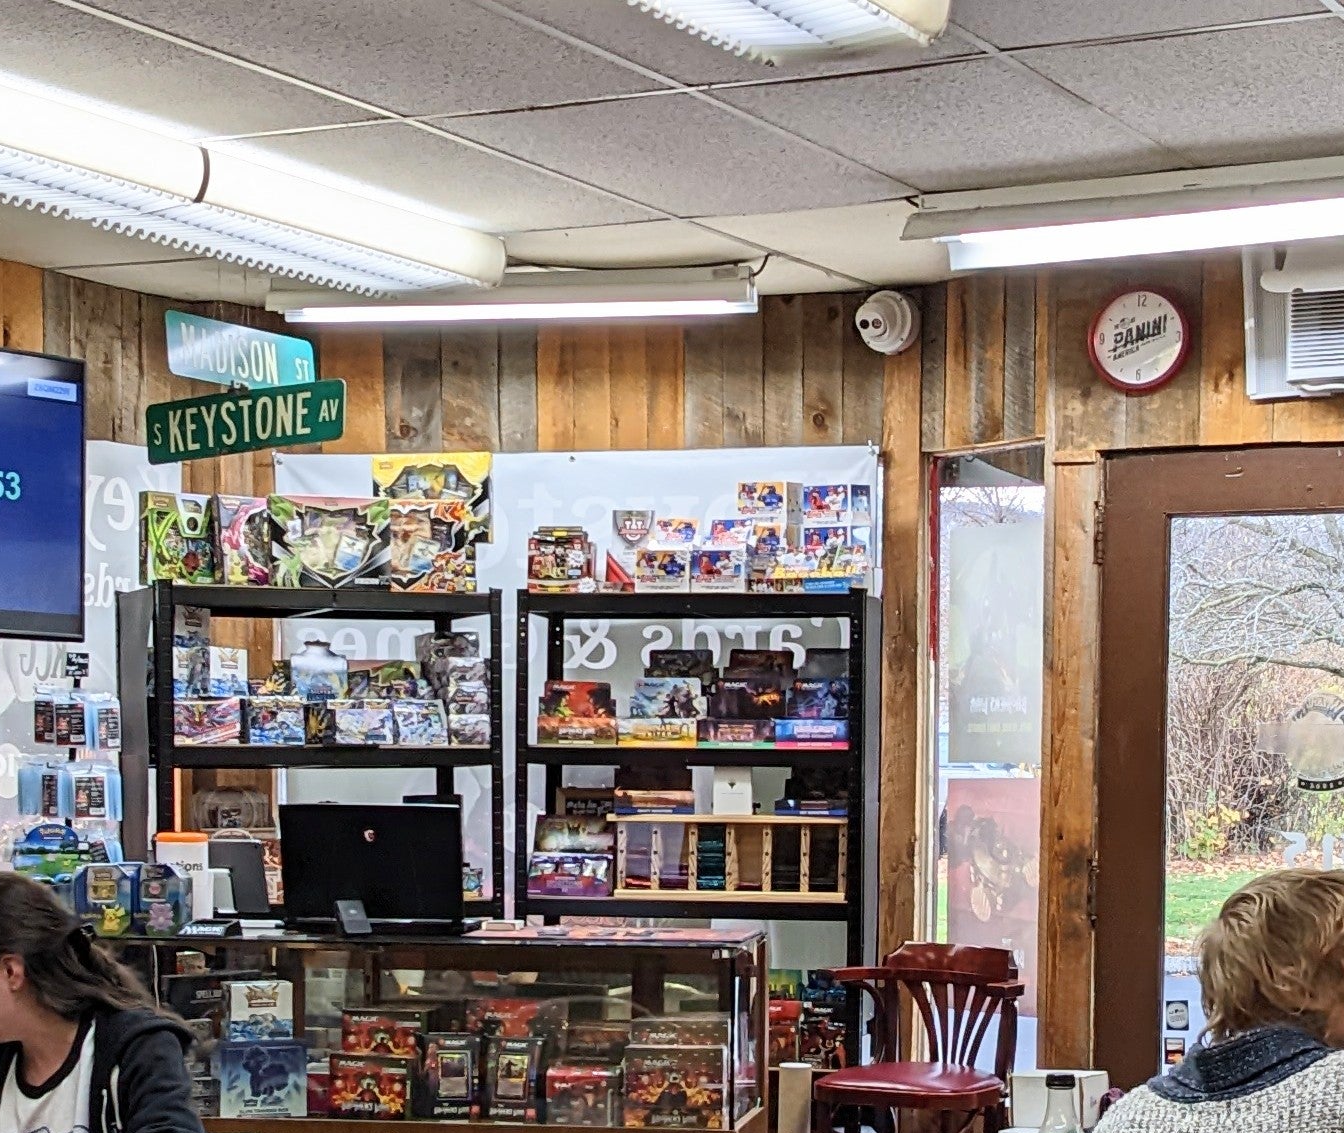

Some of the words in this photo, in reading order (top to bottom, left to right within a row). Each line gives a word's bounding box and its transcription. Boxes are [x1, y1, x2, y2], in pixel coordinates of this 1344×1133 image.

[1137, 294, 1147, 307] 12
[180, 321, 278, 385] MADISON
[295, 356, 311, 382] ST
[1112, 314, 1167, 350] PANINI
[153, 422, 163, 446] S
[168, 390, 313, 455] KEYSTONE
[318, 398, 340, 423] AV
